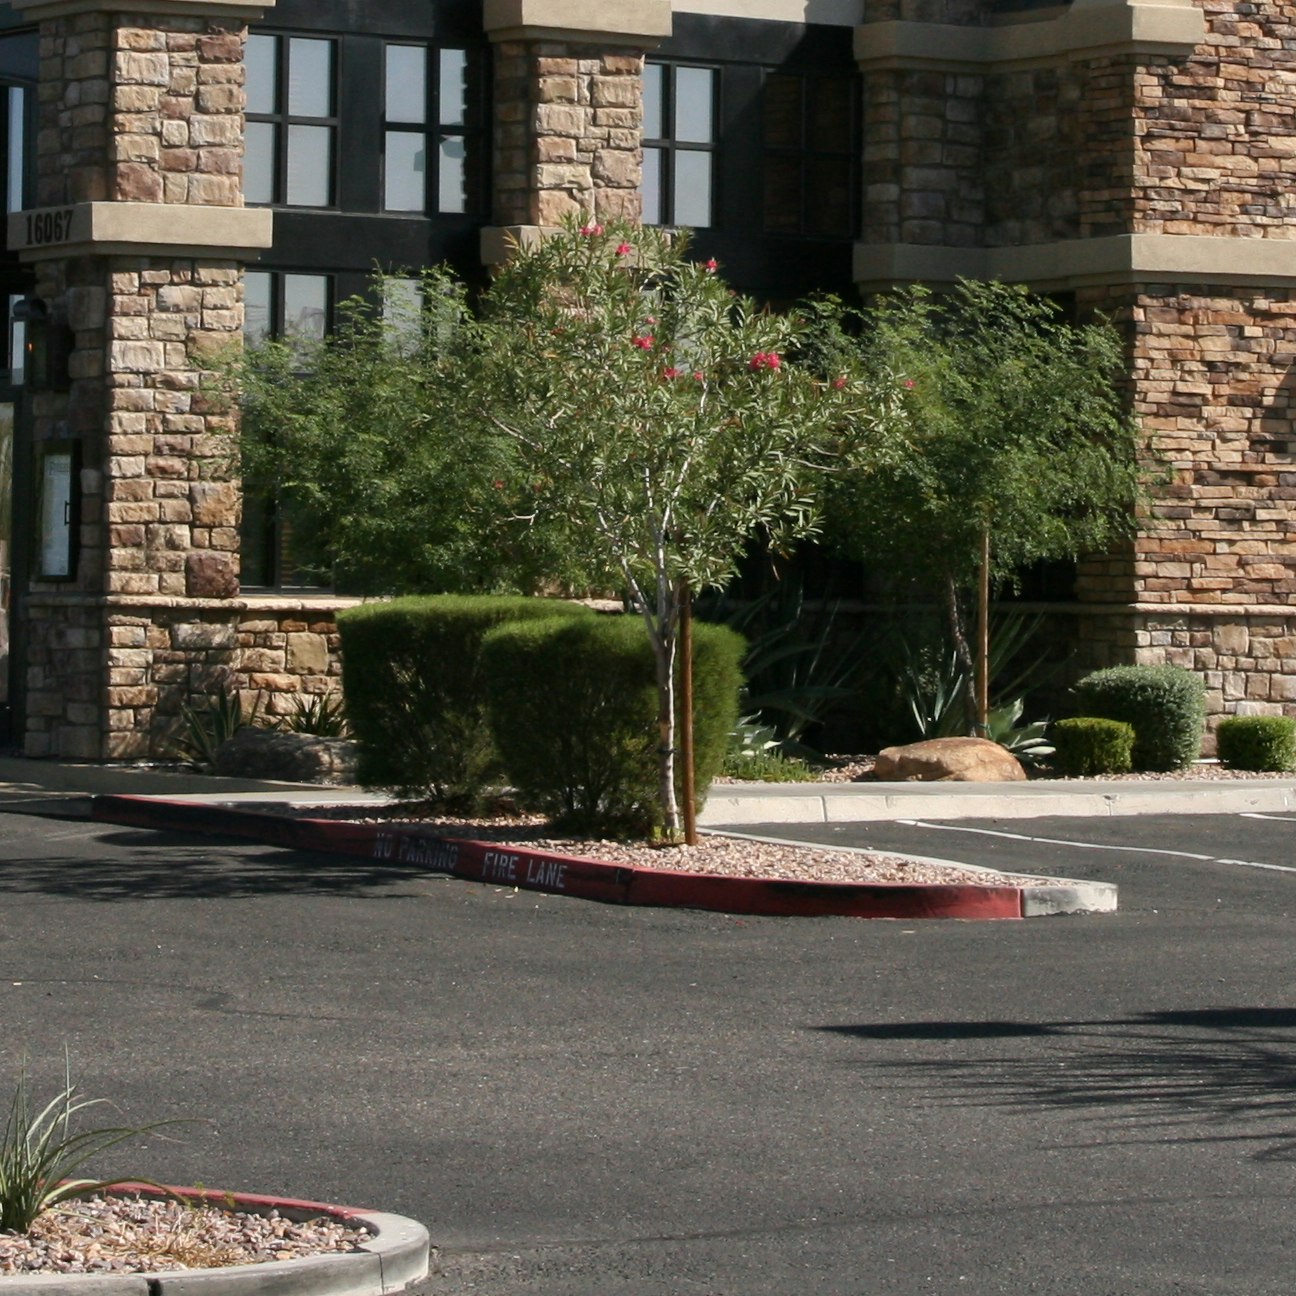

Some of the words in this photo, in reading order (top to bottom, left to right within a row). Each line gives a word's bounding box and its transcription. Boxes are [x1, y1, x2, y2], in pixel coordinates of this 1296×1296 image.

[26, 209, 74, 245] 16067
[374, 833, 393, 858] NO
[398, 836, 459, 869] PARKING
[482, 852, 519, 880] FIRE
[526, 858, 568, 888] LANE
